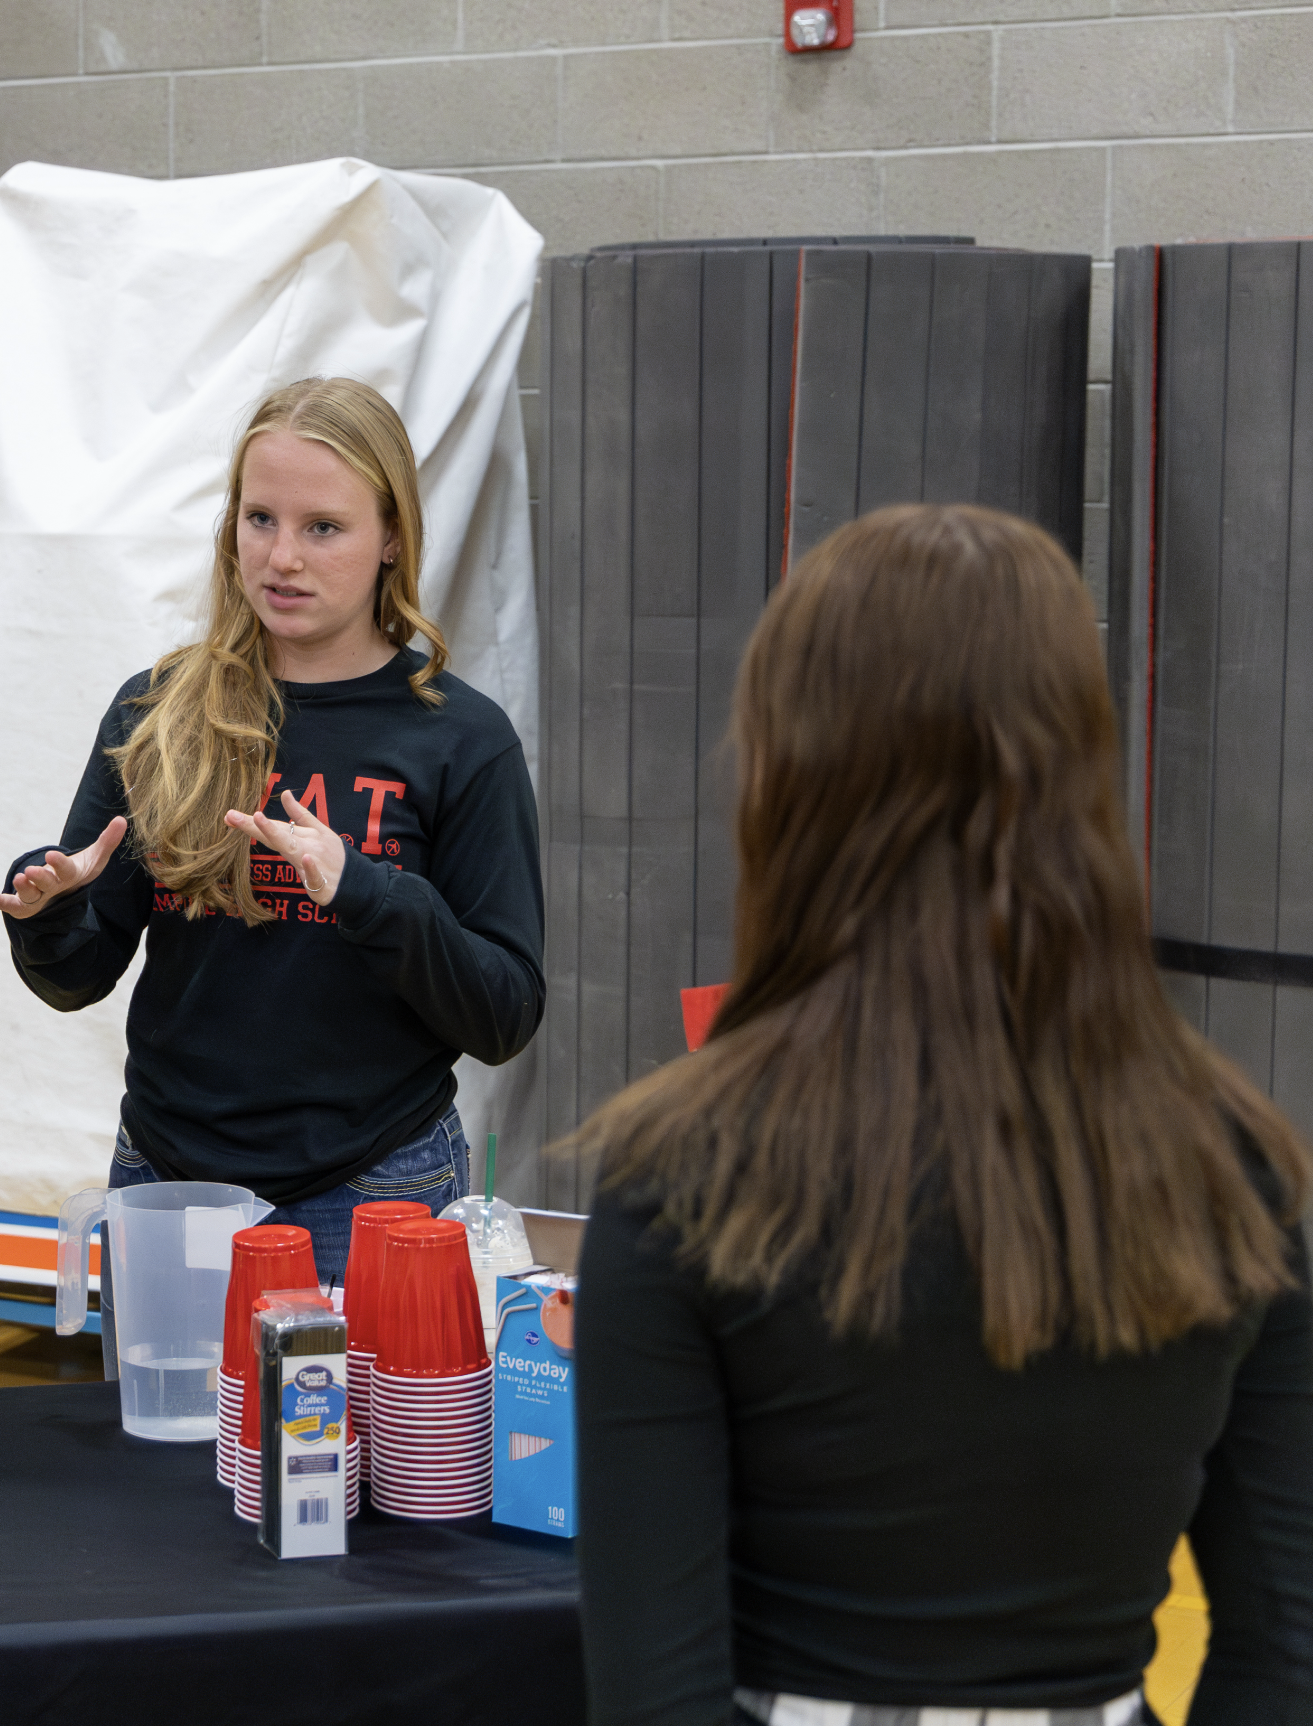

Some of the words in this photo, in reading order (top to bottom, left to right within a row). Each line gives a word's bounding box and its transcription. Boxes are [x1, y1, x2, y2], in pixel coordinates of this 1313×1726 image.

[498, 1351, 569, 1382] Everyday
[298, 1370, 327, 1381] Great
[498, 1373, 529, 1385] STRIPED
[531, 1380, 568, 1393] FLEXIBLE
[517, 1385, 548, 1397] STRAWS
[296, 1393, 328, 1406] Coffee
[294, 1404, 330, 1416] Stirrers
[325, 1426, 341, 1435] 250
[547, 1506, 565, 1522] 100
